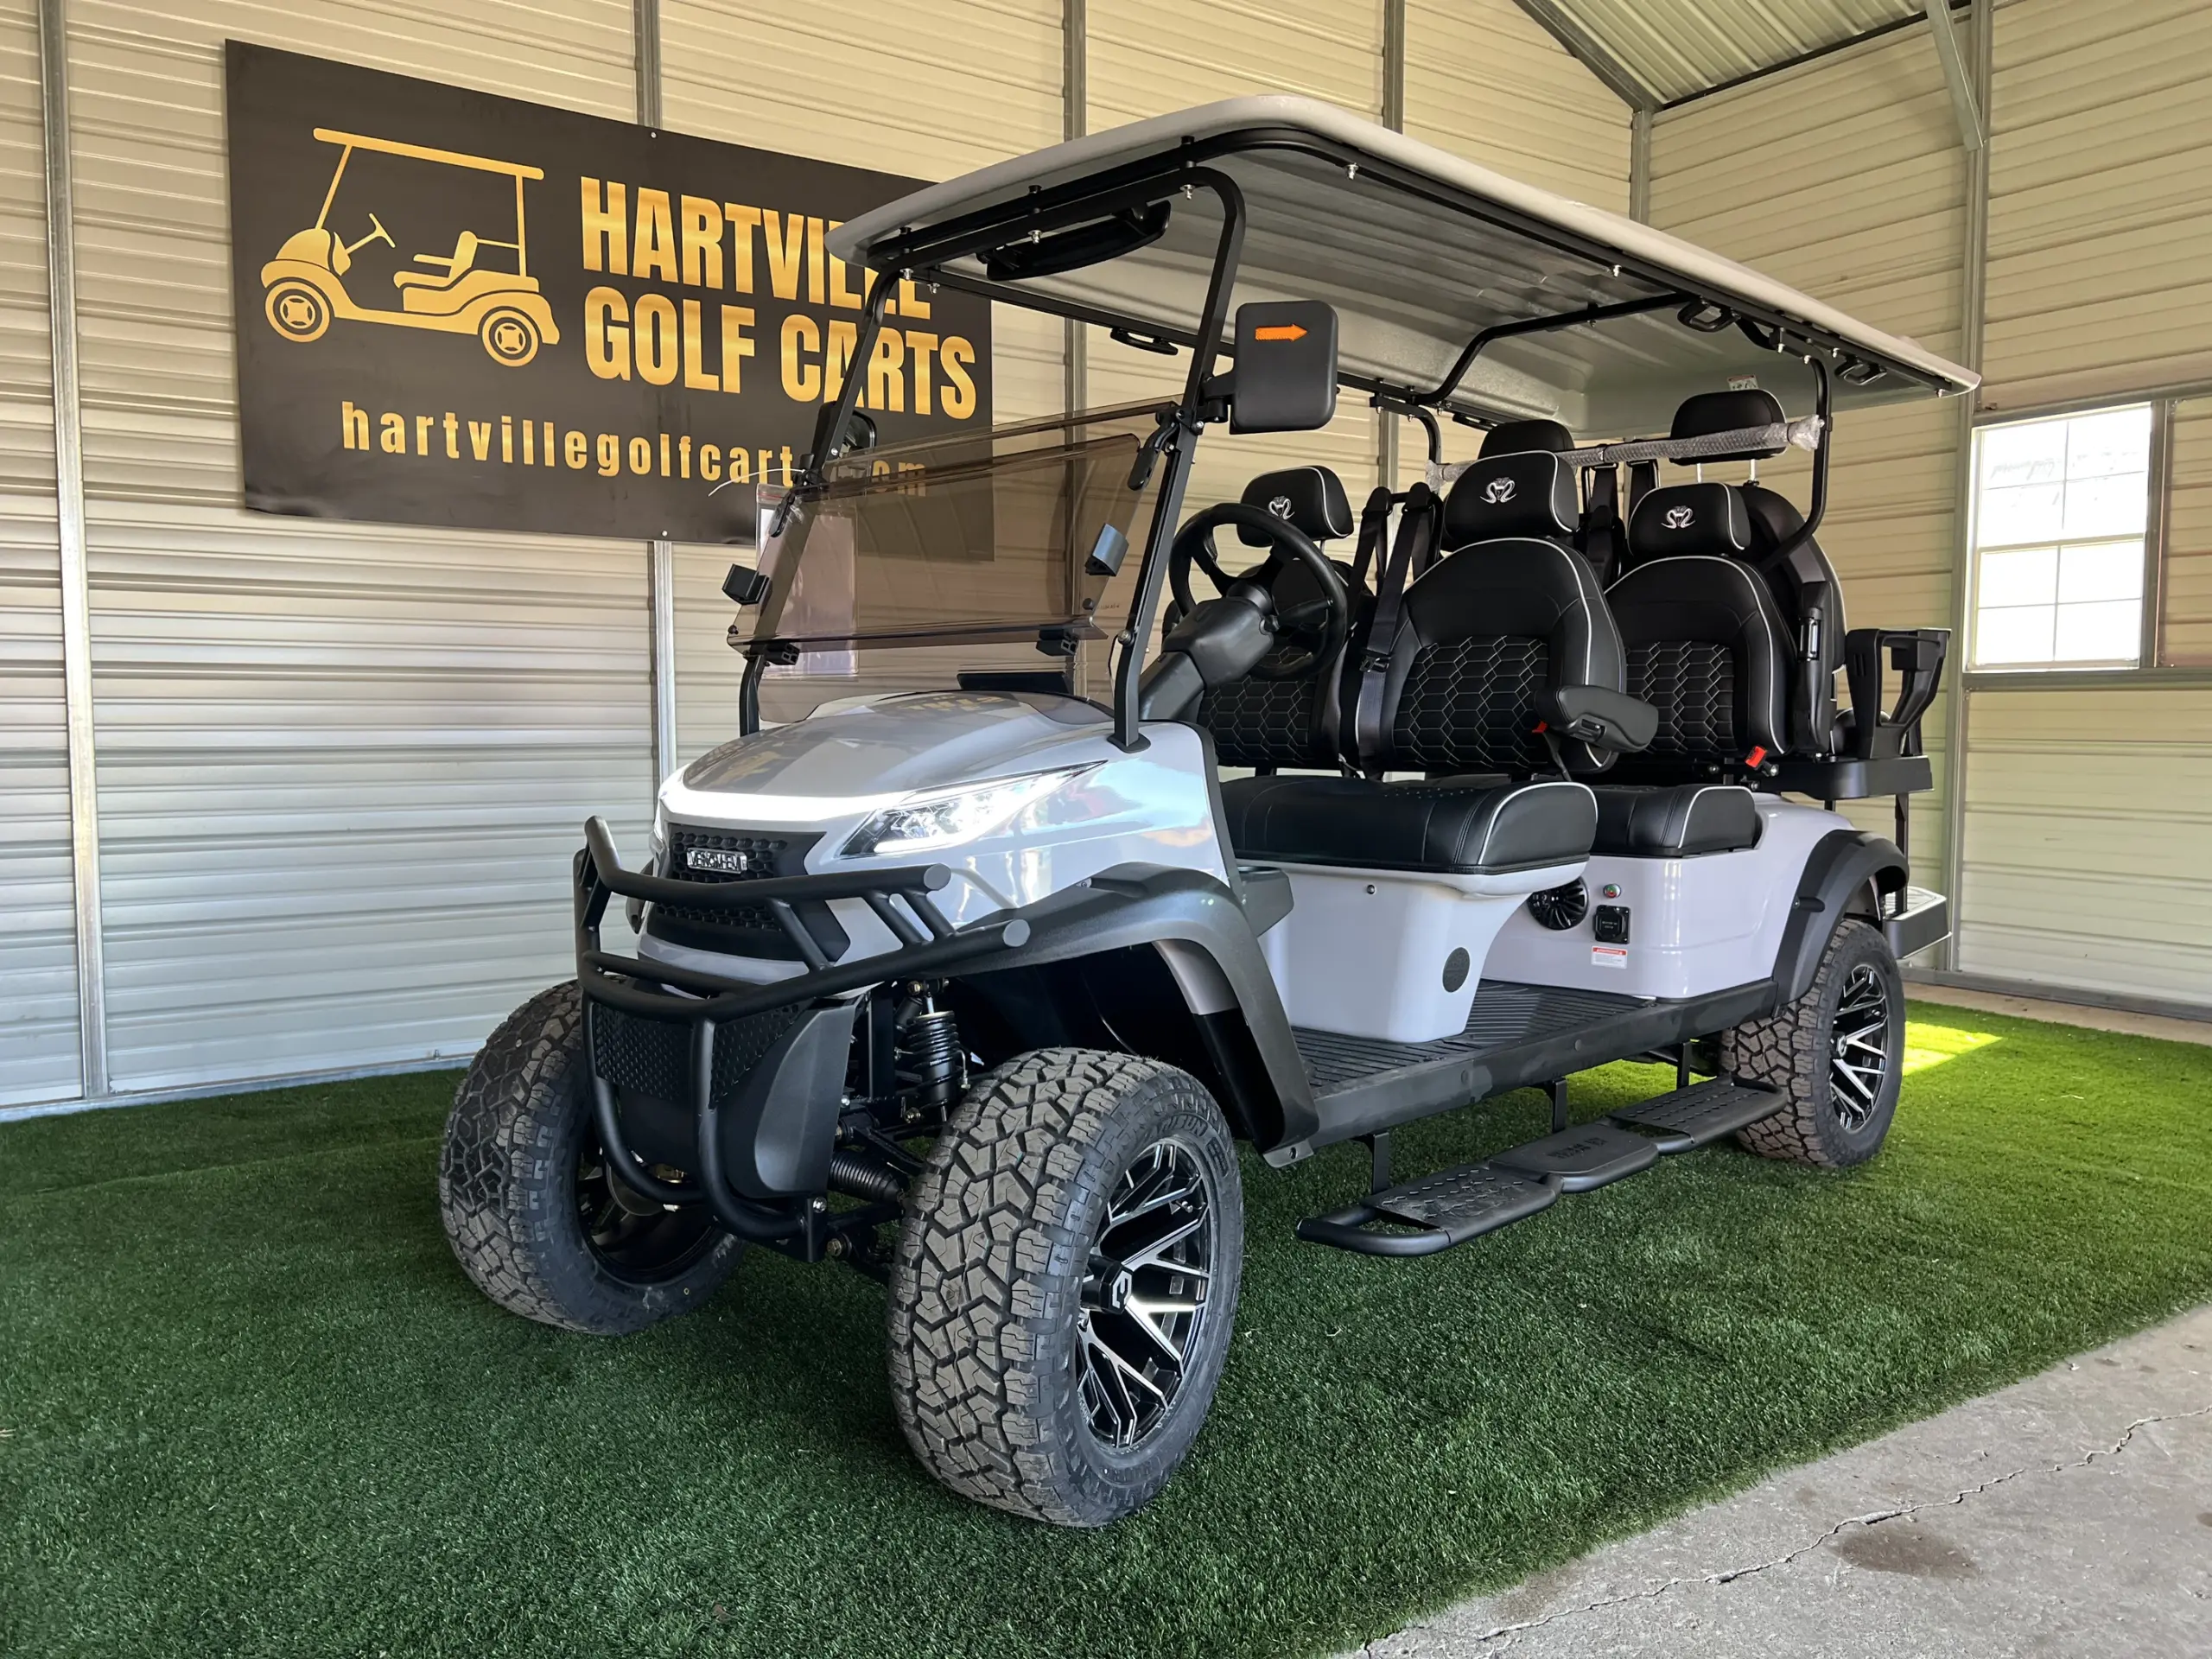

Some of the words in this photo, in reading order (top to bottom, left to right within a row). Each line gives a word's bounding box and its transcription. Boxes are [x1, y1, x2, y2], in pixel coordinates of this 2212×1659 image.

[580, 175, 931, 320] HARTVIL
[584, 286, 755, 394] GOLF
[780, 314, 976, 420] CARTS
[342, 401, 926, 497] hartvillegolfcartom
